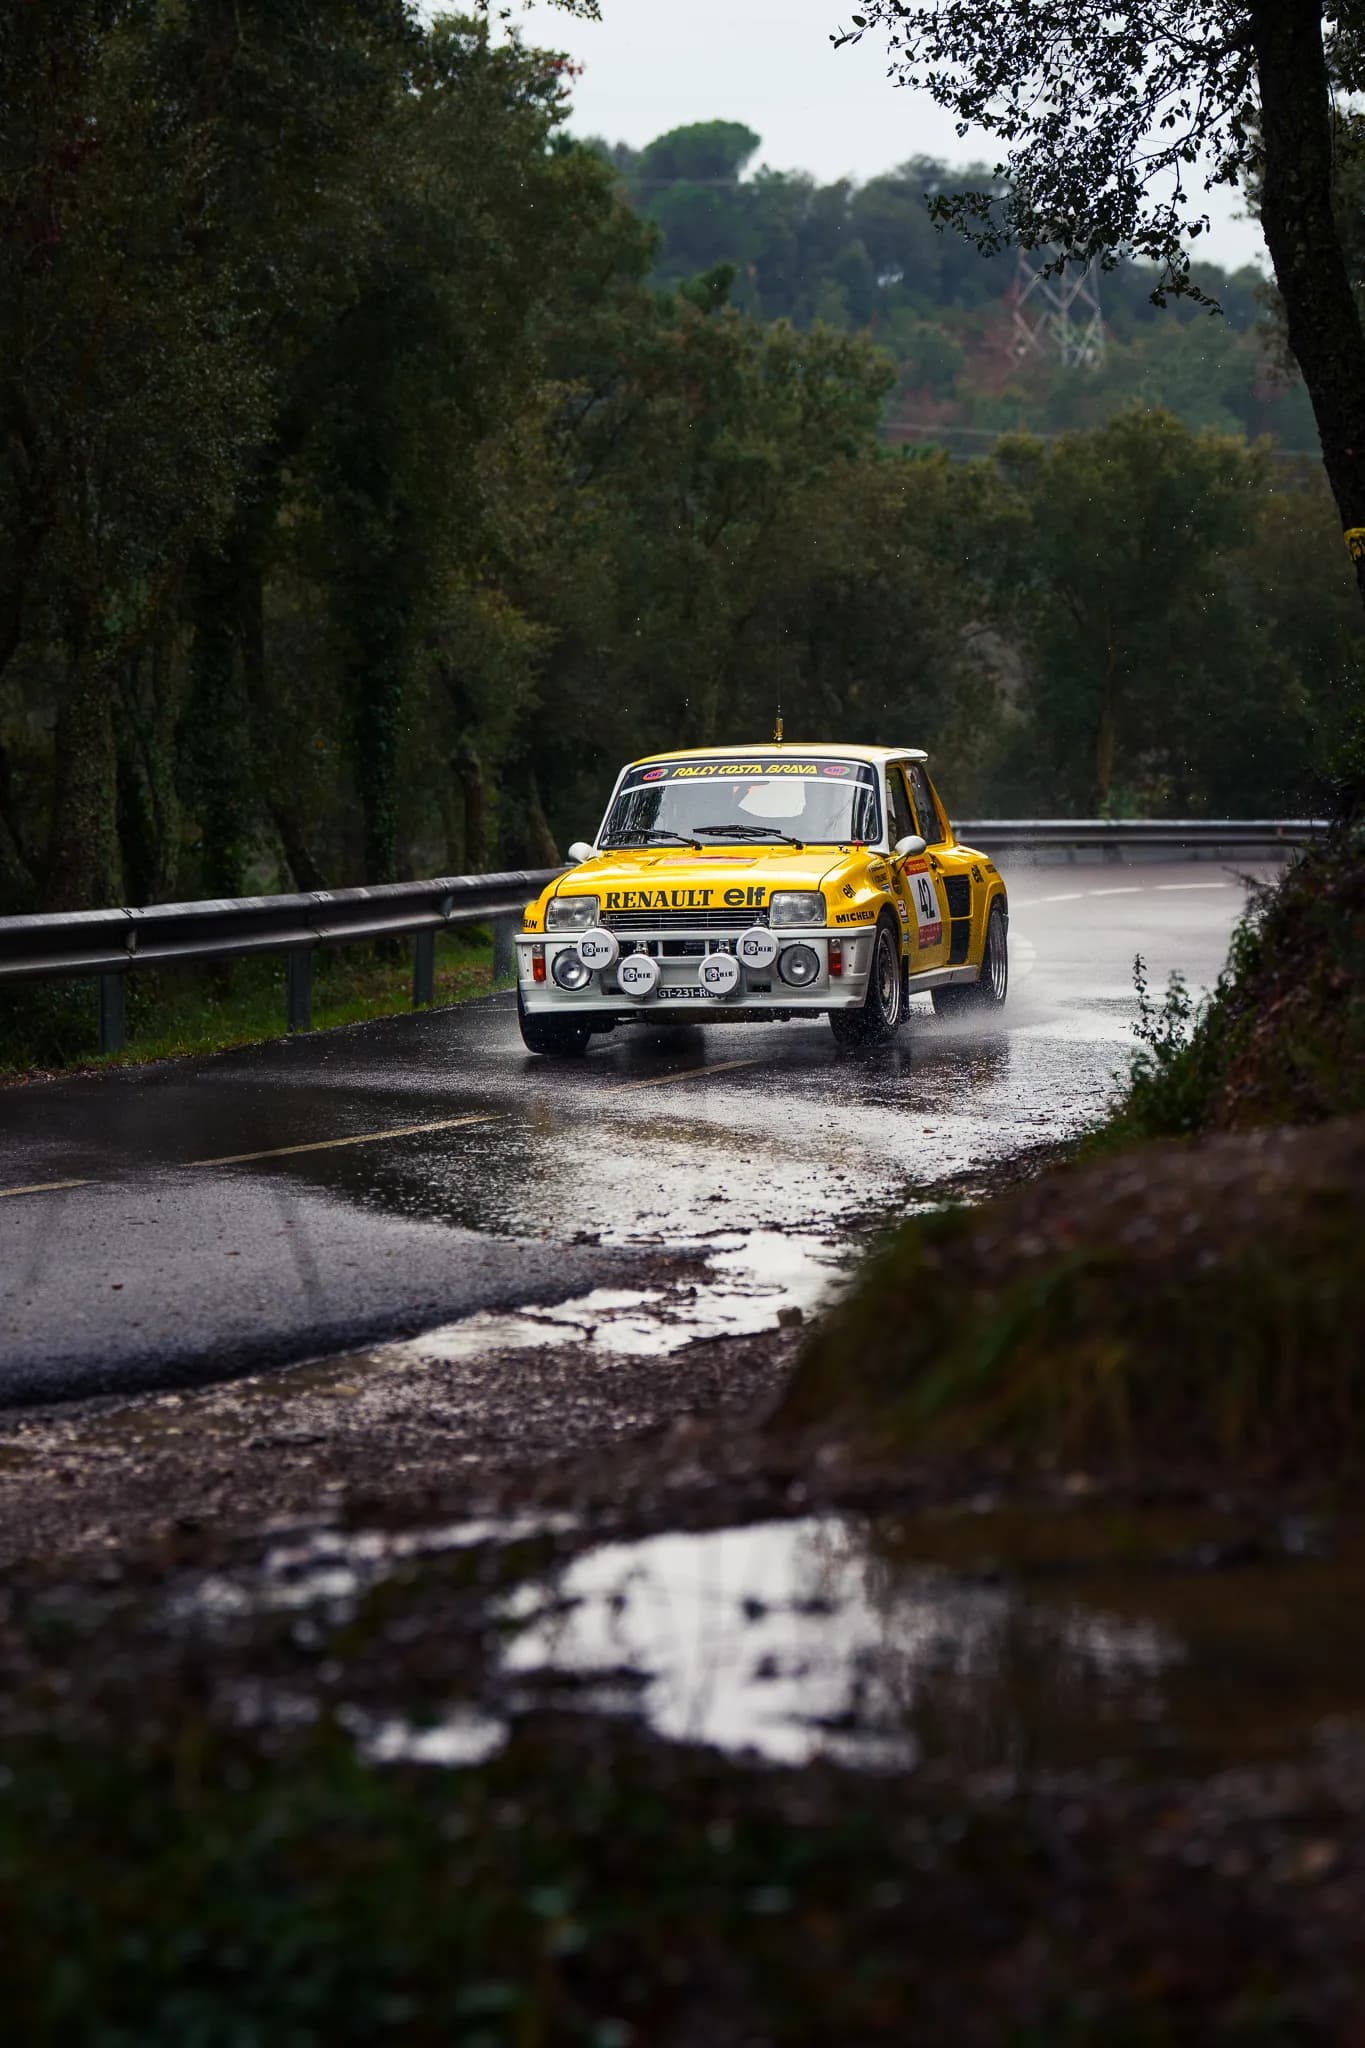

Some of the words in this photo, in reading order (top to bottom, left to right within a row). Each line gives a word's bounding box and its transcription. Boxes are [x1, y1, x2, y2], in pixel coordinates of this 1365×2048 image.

[671, 766, 718, 778] RALLY
[718, 764, 762, 775] COSTA
[765, 764, 817, 775] BRAVA
[605, 889, 713, 908] RENAULT
[723, 886, 766, 906] elf
[842, 884, 856, 898] elf
[917, 878, 935, 919] 42
[835, 910, 875, 923] MICHELIN
